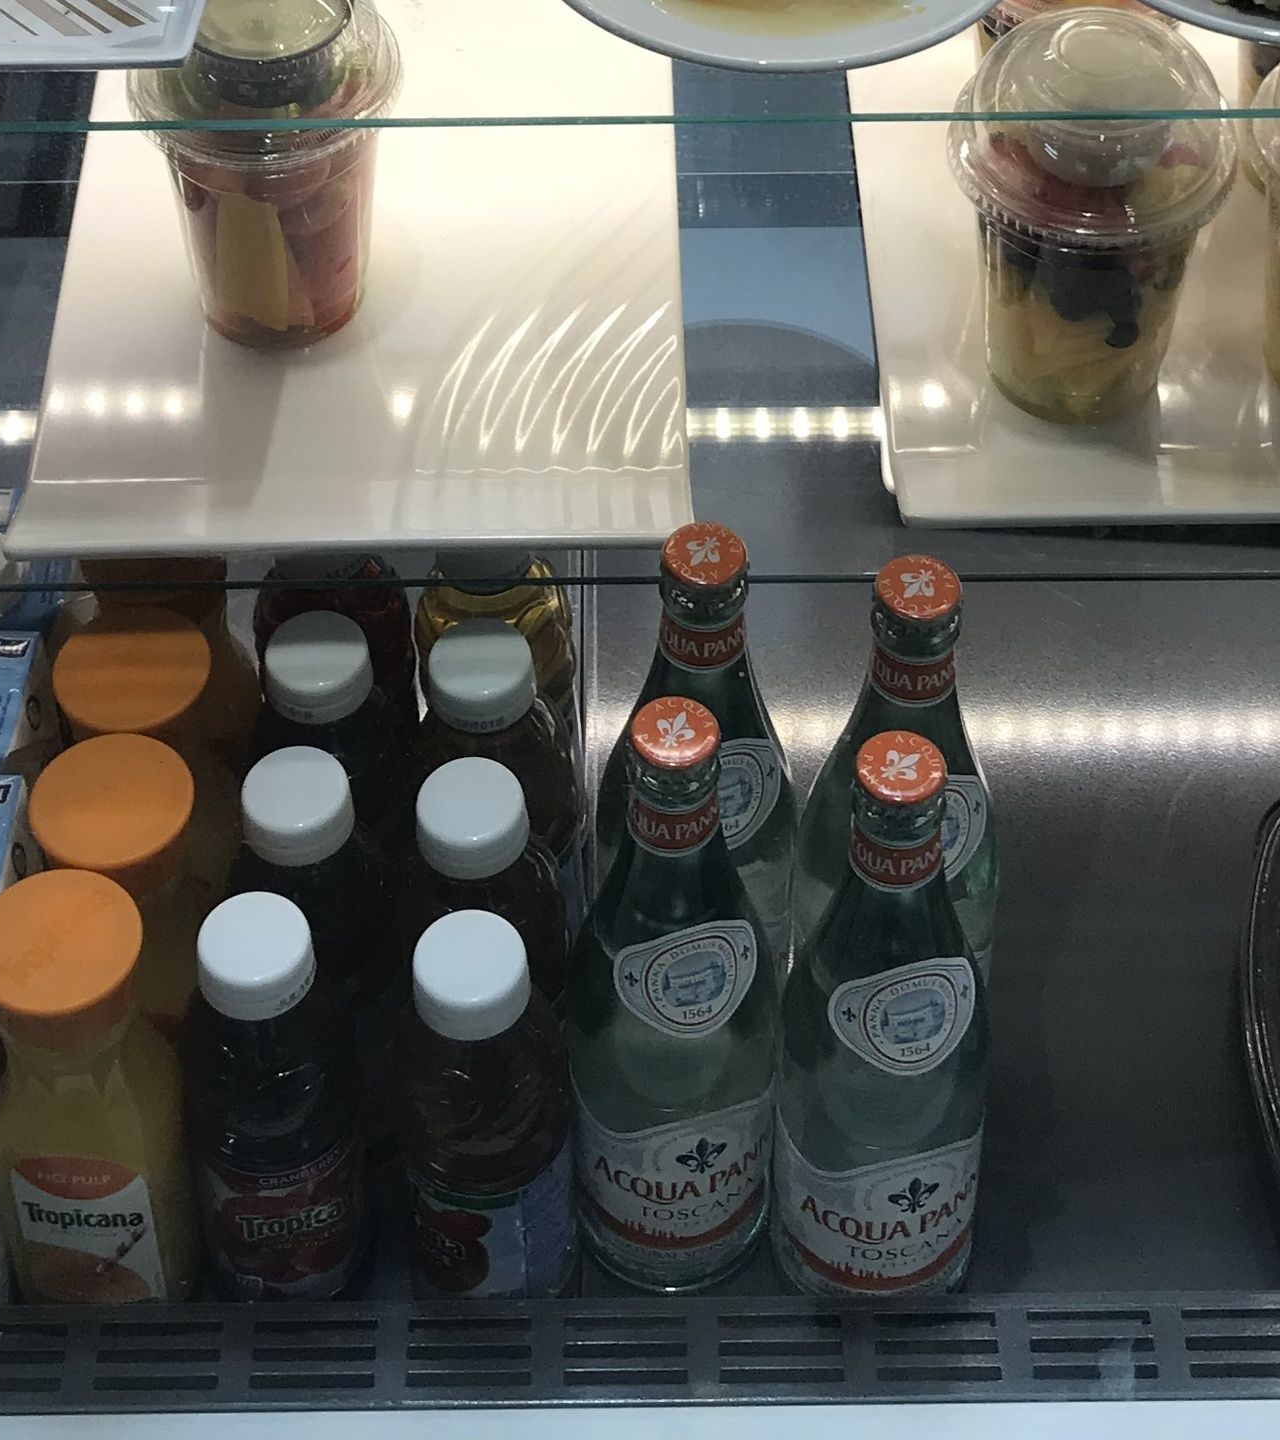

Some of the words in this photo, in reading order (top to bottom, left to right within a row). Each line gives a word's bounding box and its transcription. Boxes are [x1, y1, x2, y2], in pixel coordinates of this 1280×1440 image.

[663, 627, 700, 657] QUA
[654, 700, 714, 729] ACQUA
[650, 961, 666, 1002] PANNA
[681, 1005, 713, 1020] 1564
[868, 998, 885, 1039] PANNA
[899, 1042, 931, 1057] 1564
[70, 1173, 112, 1186] PULP
[593, 1154, 701, 1205] ACQUA
[21, 1200, 145, 1230] Tropicana
[800, 1194, 912, 1245] ACQUA
